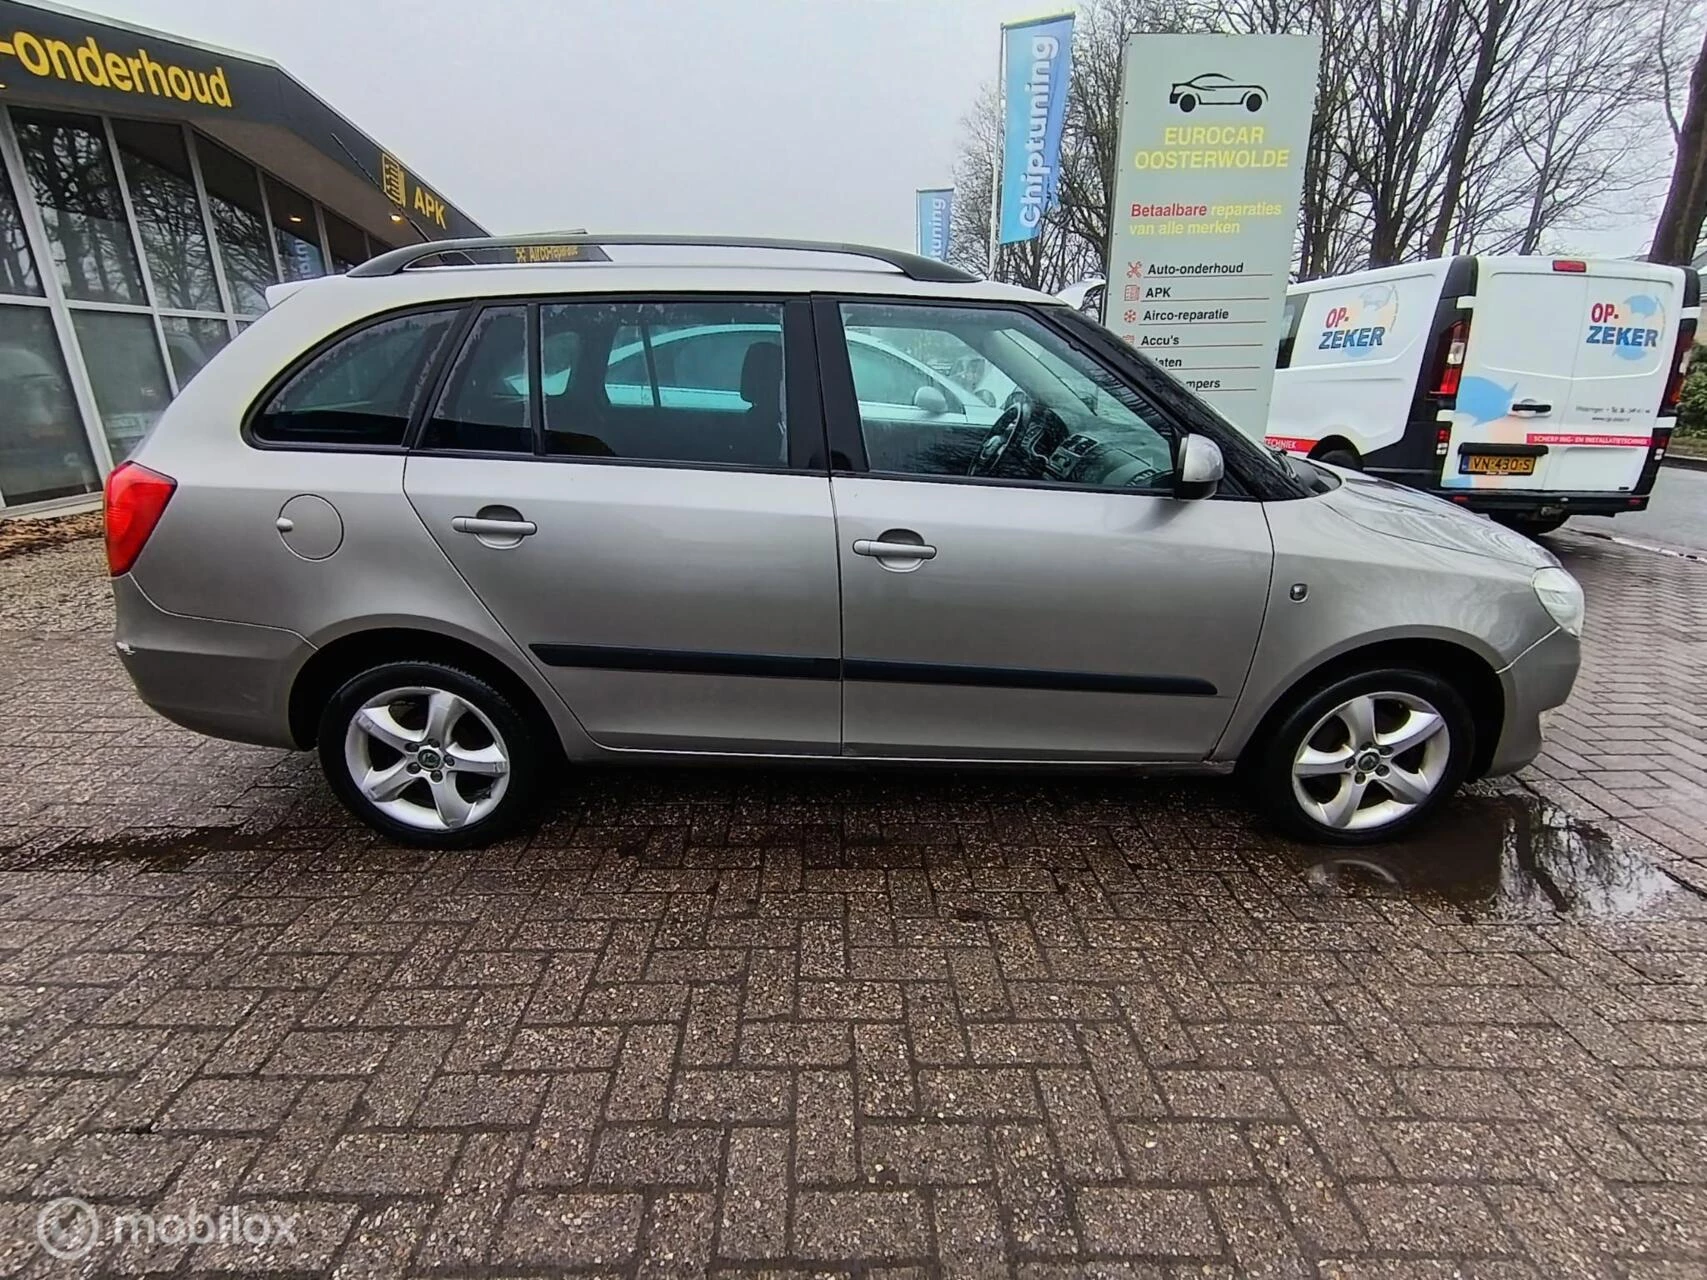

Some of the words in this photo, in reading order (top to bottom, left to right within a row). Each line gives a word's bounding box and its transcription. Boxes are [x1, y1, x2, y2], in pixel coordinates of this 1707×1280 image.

[1164, 126, 1265, 145] EUROCAR
[1135, 150, 1290, 170] OOSTERWOLDE
[414, 186, 447, 231] APK
[1131, 204, 1207, 217] Betaalbare
[1211, 203, 1282, 218] reparaties
[1129, 223, 1154, 236] van
[1158, 221, 1184, 235] alle
[1187, 221, 1240, 235] merken
[1147, 262, 1244, 275] Auto-onderhoud
[1145, 287, 1171, 298] APK
[1143, 309, 1229, 322] Airco-reparatie
[1140, 335, 1180, 346] Accu's
[1319, 326, 1386, 350] ZEKER
[1586, 326, 1659, 348] ZEKER
